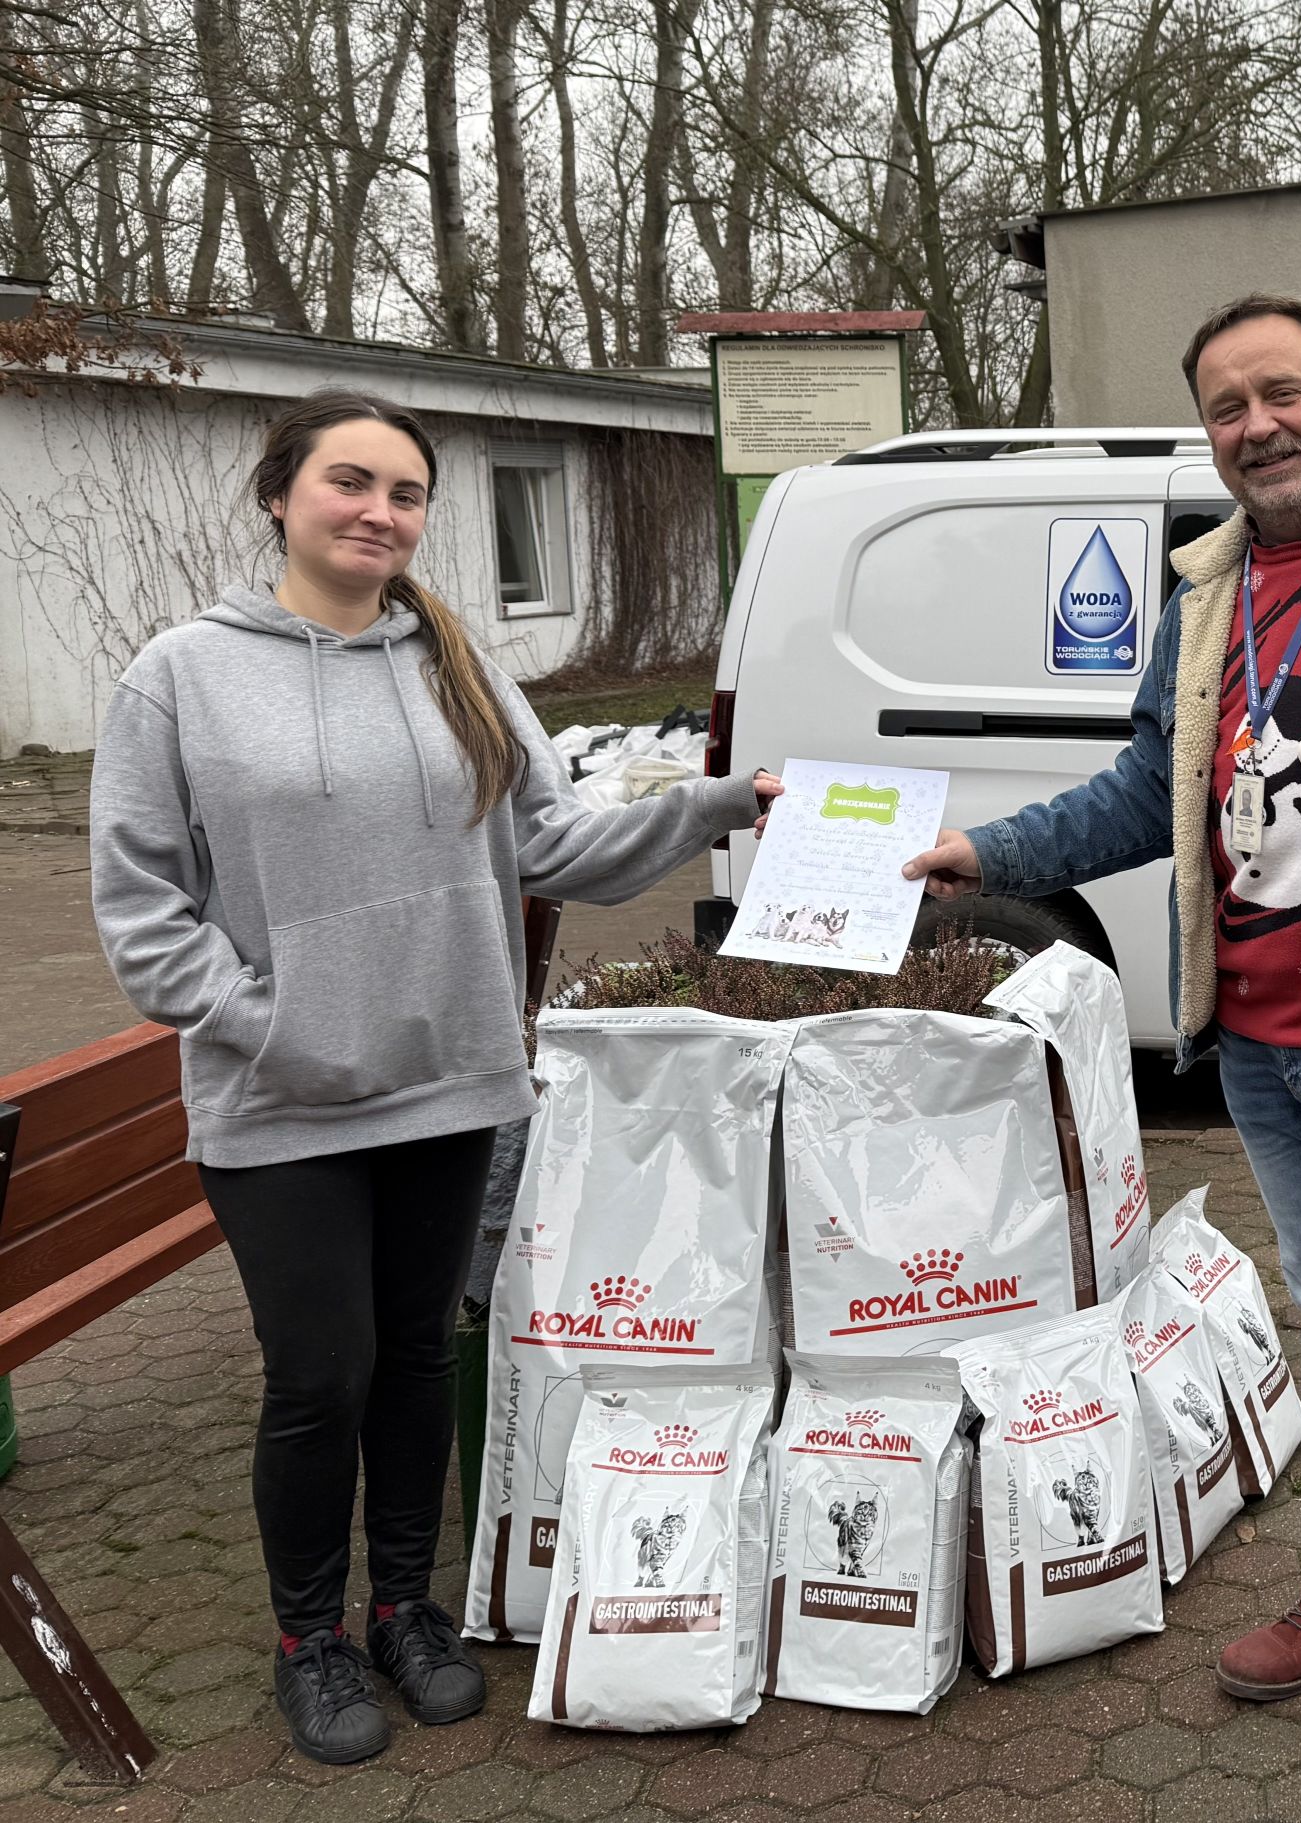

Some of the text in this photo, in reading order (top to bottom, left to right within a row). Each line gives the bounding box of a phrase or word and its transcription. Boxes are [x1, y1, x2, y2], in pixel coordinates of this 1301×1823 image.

[1070, 592, 1122, 606] WODA
[1077, 609, 1122, 620] gwarancją
[1055, 645, 1109, 653] TORUŃSKIE
[1055, 652, 1110, 661] WODOCIĄGI
[738, 1047, 763, 1059] 15 kg
[1114, 1193, 1136, 1233] ROYAL
[814, 1236, 856, 1247] VETERINARY
[816, 1244, 854, 1253] NUTRITION
[516, 1251, 553, 1260] NUTRITION
[1203, 1253, 1231, 1284] CANIN
[849, 1275, 1018, 1322] ROYAL CANIN
[529, 1310, 696, 1342] ROYAL CANIN
[1144, 1318, 1181, 1356] CANIN
[1220, 1327, 1246, 1392] VETERIN
[1052, 1398, 1103, 1427] CANIN
[501, 1363, 521, 1505] VETERINARY
[805, 1430, 911, 1453] ROYAL CANIN
[609, 1447, 728, 1467] ROYAL CANIN
[1008, 1455, 1019, 1558] VETERINA
[1047, 1538, 1146, 1583] GASTROINTESTINAL
[901, 1572, 918, 1581] S/O
[595, 1600, 716, 1619] GASTROINTESTINAL
[804, 1586, 913, 1613] GASTROINTESTINAL
